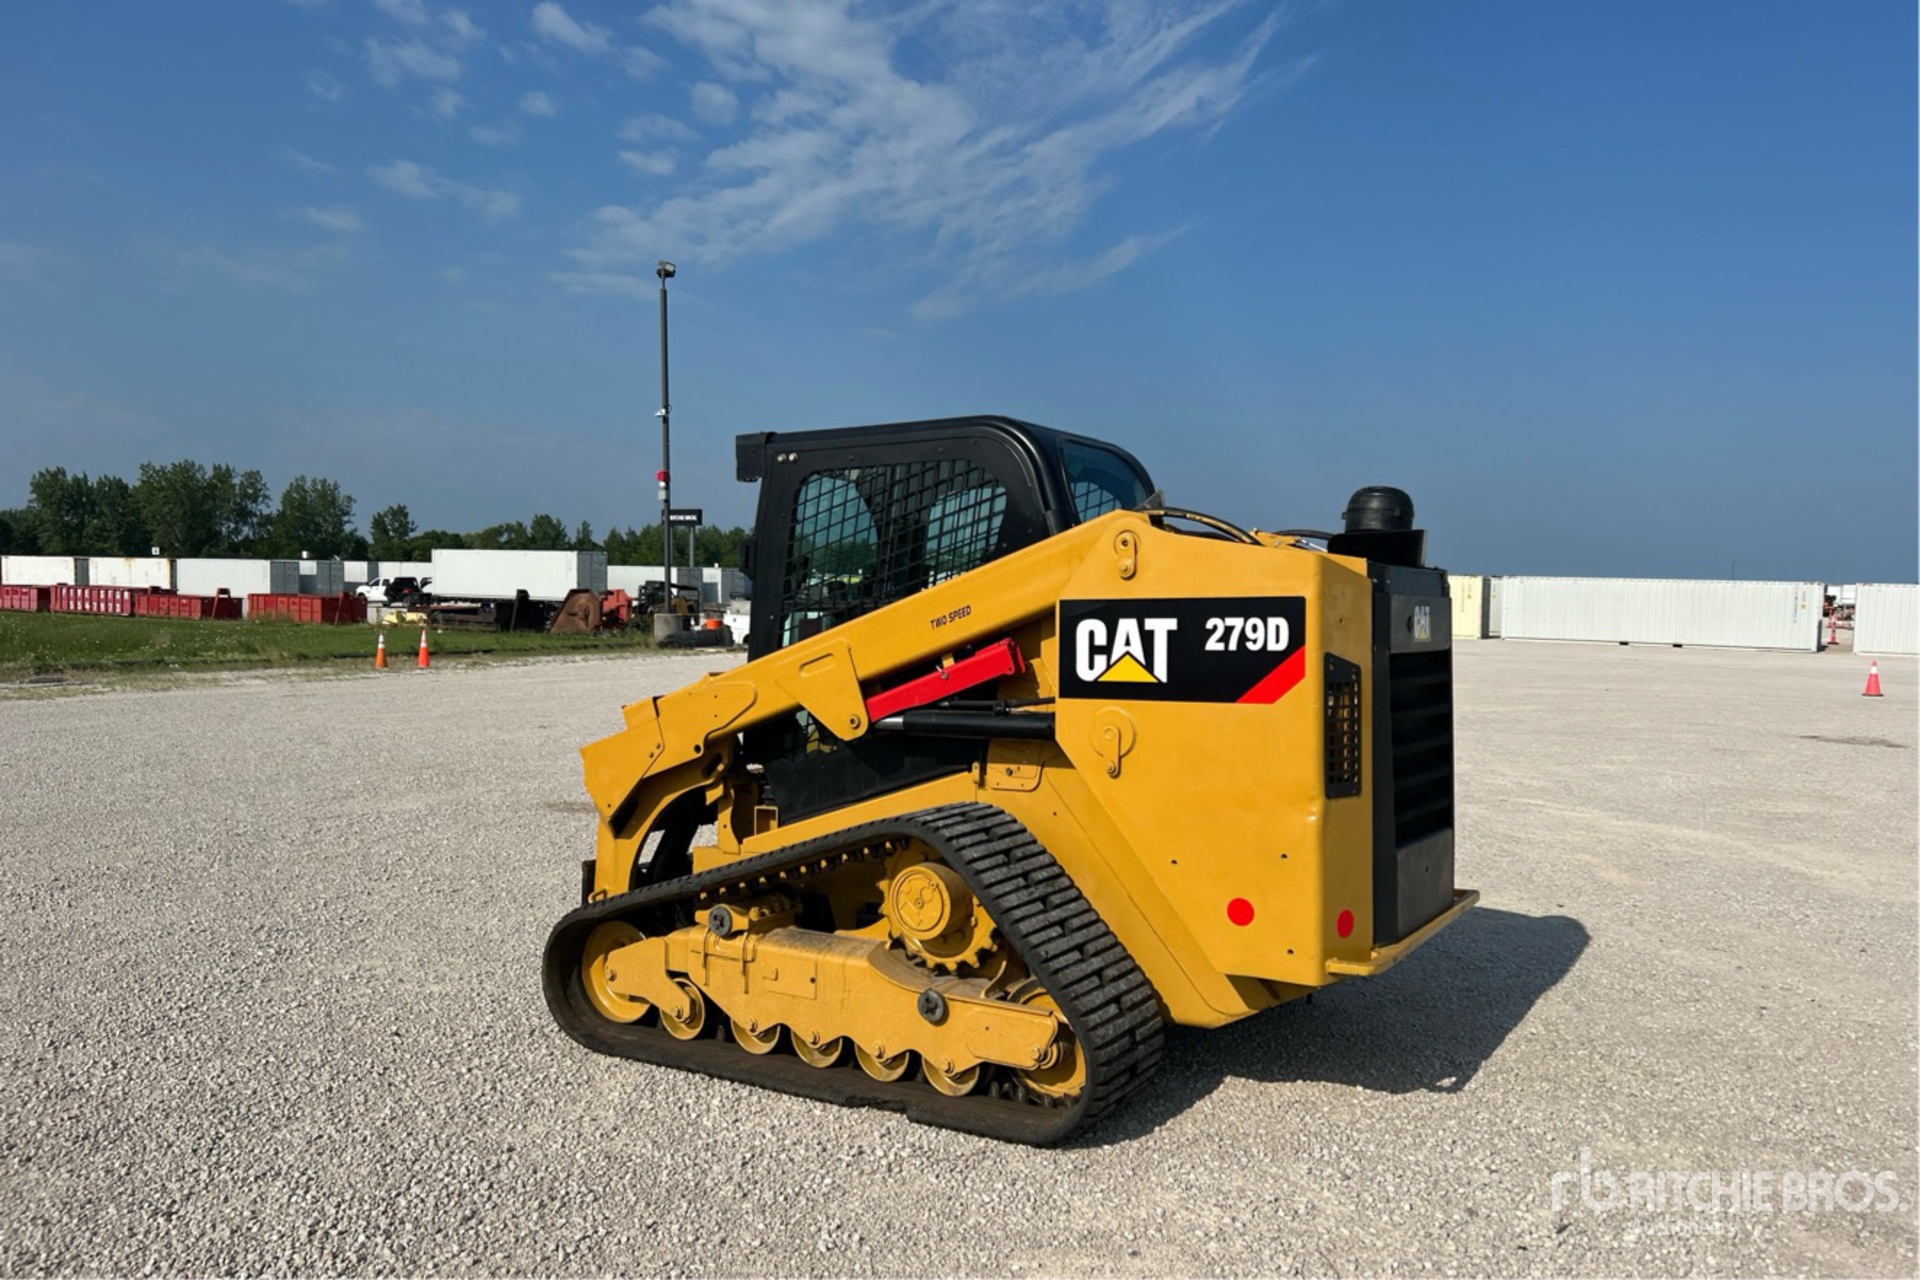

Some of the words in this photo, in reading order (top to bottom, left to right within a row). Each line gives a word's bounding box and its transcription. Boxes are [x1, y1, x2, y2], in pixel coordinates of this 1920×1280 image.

[930, 614, 947, 630] TWO
[949, 605, 971, 623] SPEED
[1204, 616, 1290, 652] 279D
[1414, 605, 1430, 640] CAT
[1075, 617, 1178, 684] CAT
